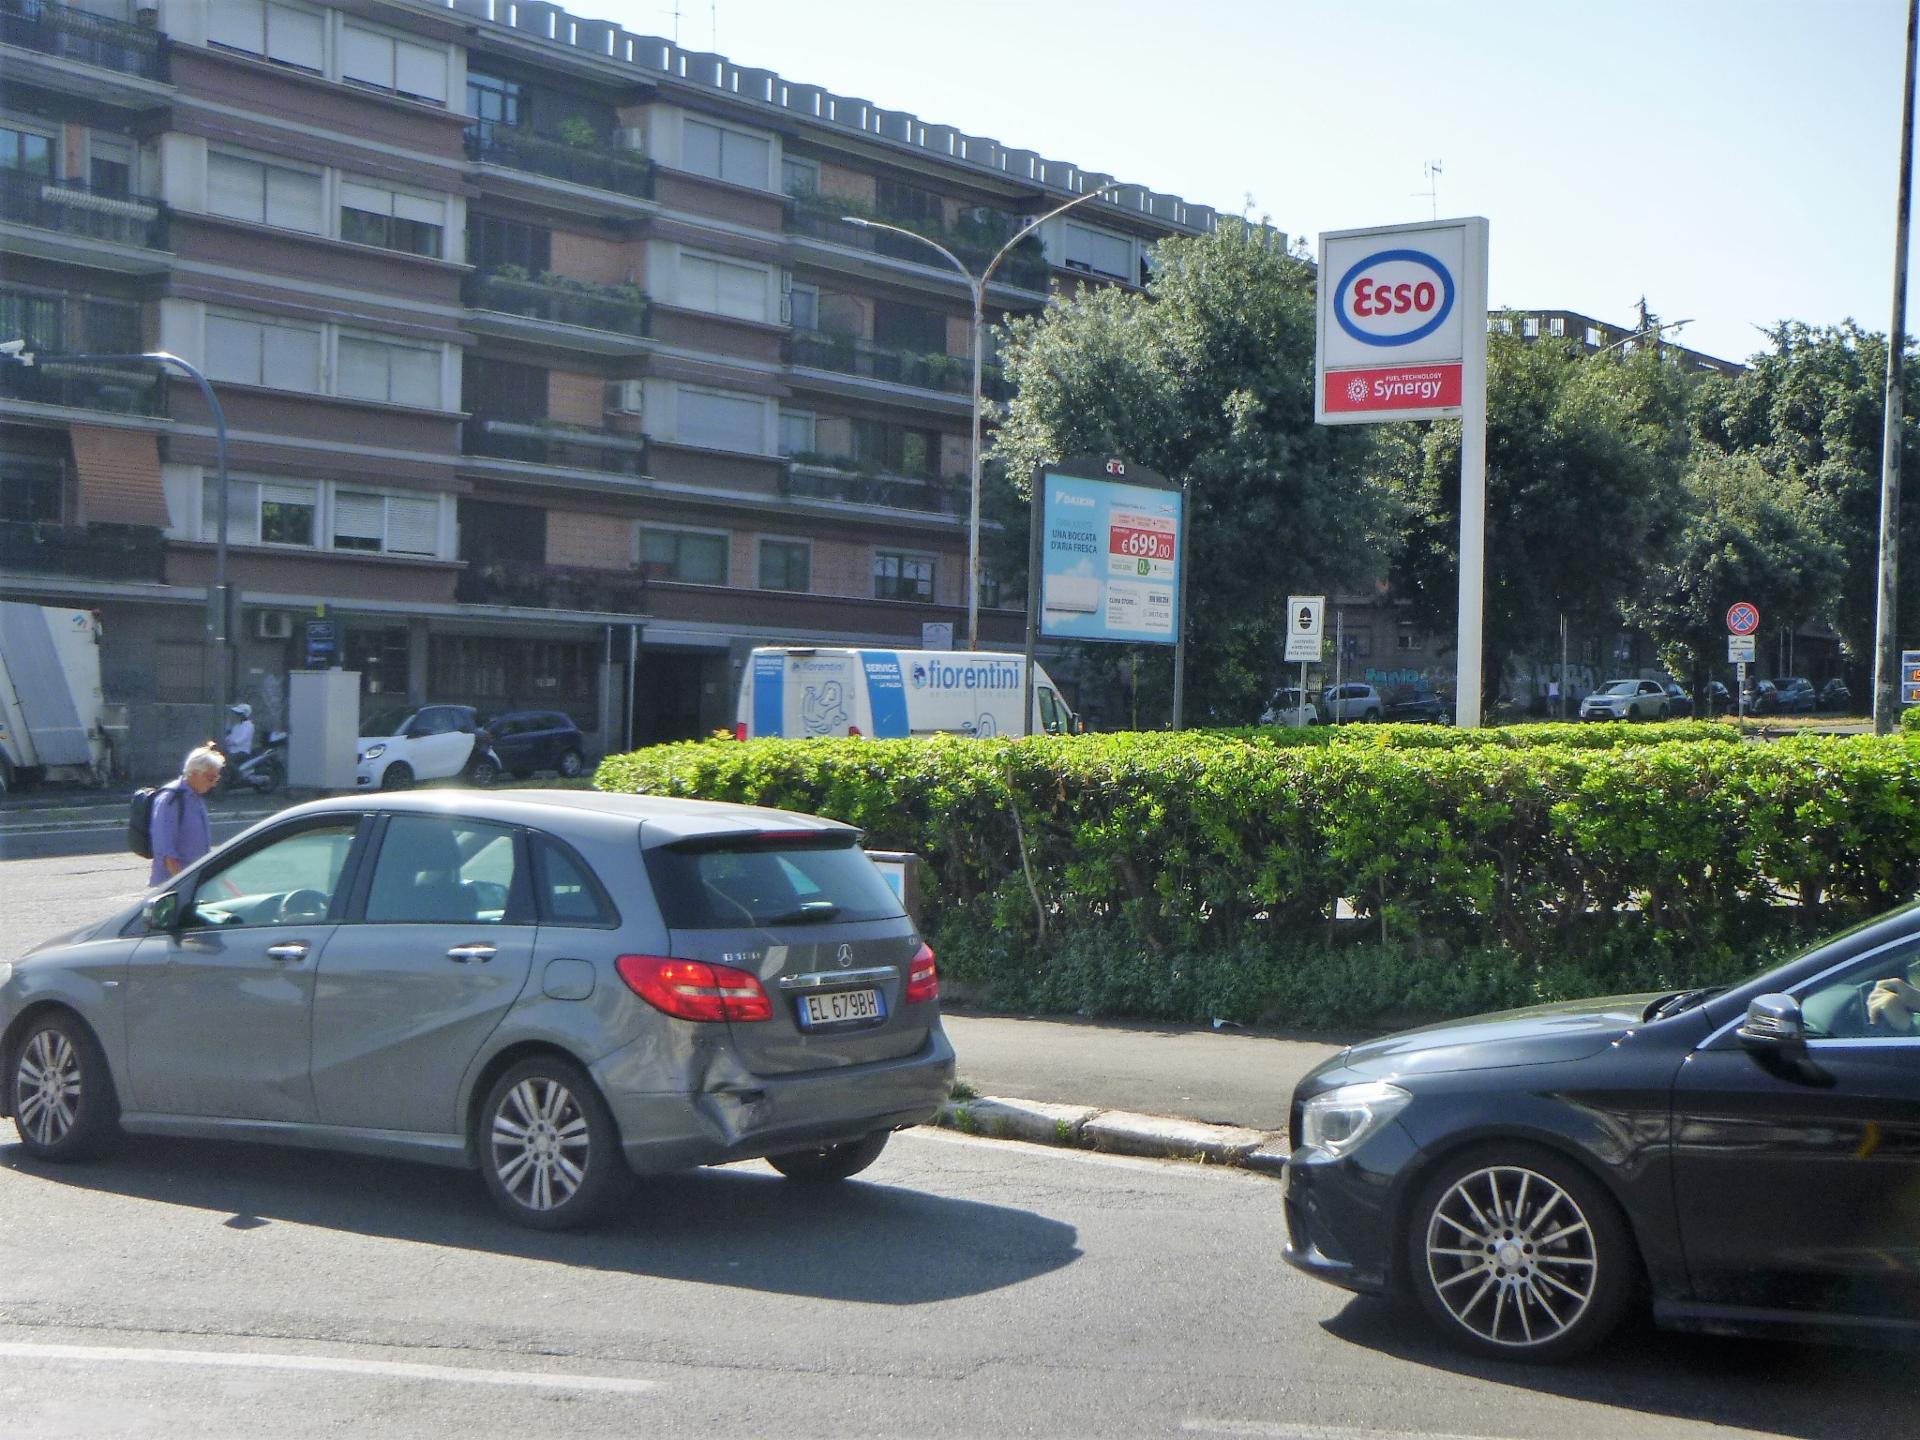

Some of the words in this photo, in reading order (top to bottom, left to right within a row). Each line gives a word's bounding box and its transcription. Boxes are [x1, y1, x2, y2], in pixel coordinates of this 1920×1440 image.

[1402, 372, 1442, 381] TECHNOLOGY
[1374, 380, 1442, 401] Synergy
[1052, 529, 1067, 540] UNA
[1068, 531, 1097, 543] BOCCATA
[1051, 541, 1073, 552] D'ARIA
[1074, 542, 1098, 554] FRESCA
[865, 663, 898, 672] SERVICE
[928, 659, 1019, 689] fiorentini
[808, 997, 829, 1022] EL
[832, 991, 879, 1019] 679BH
